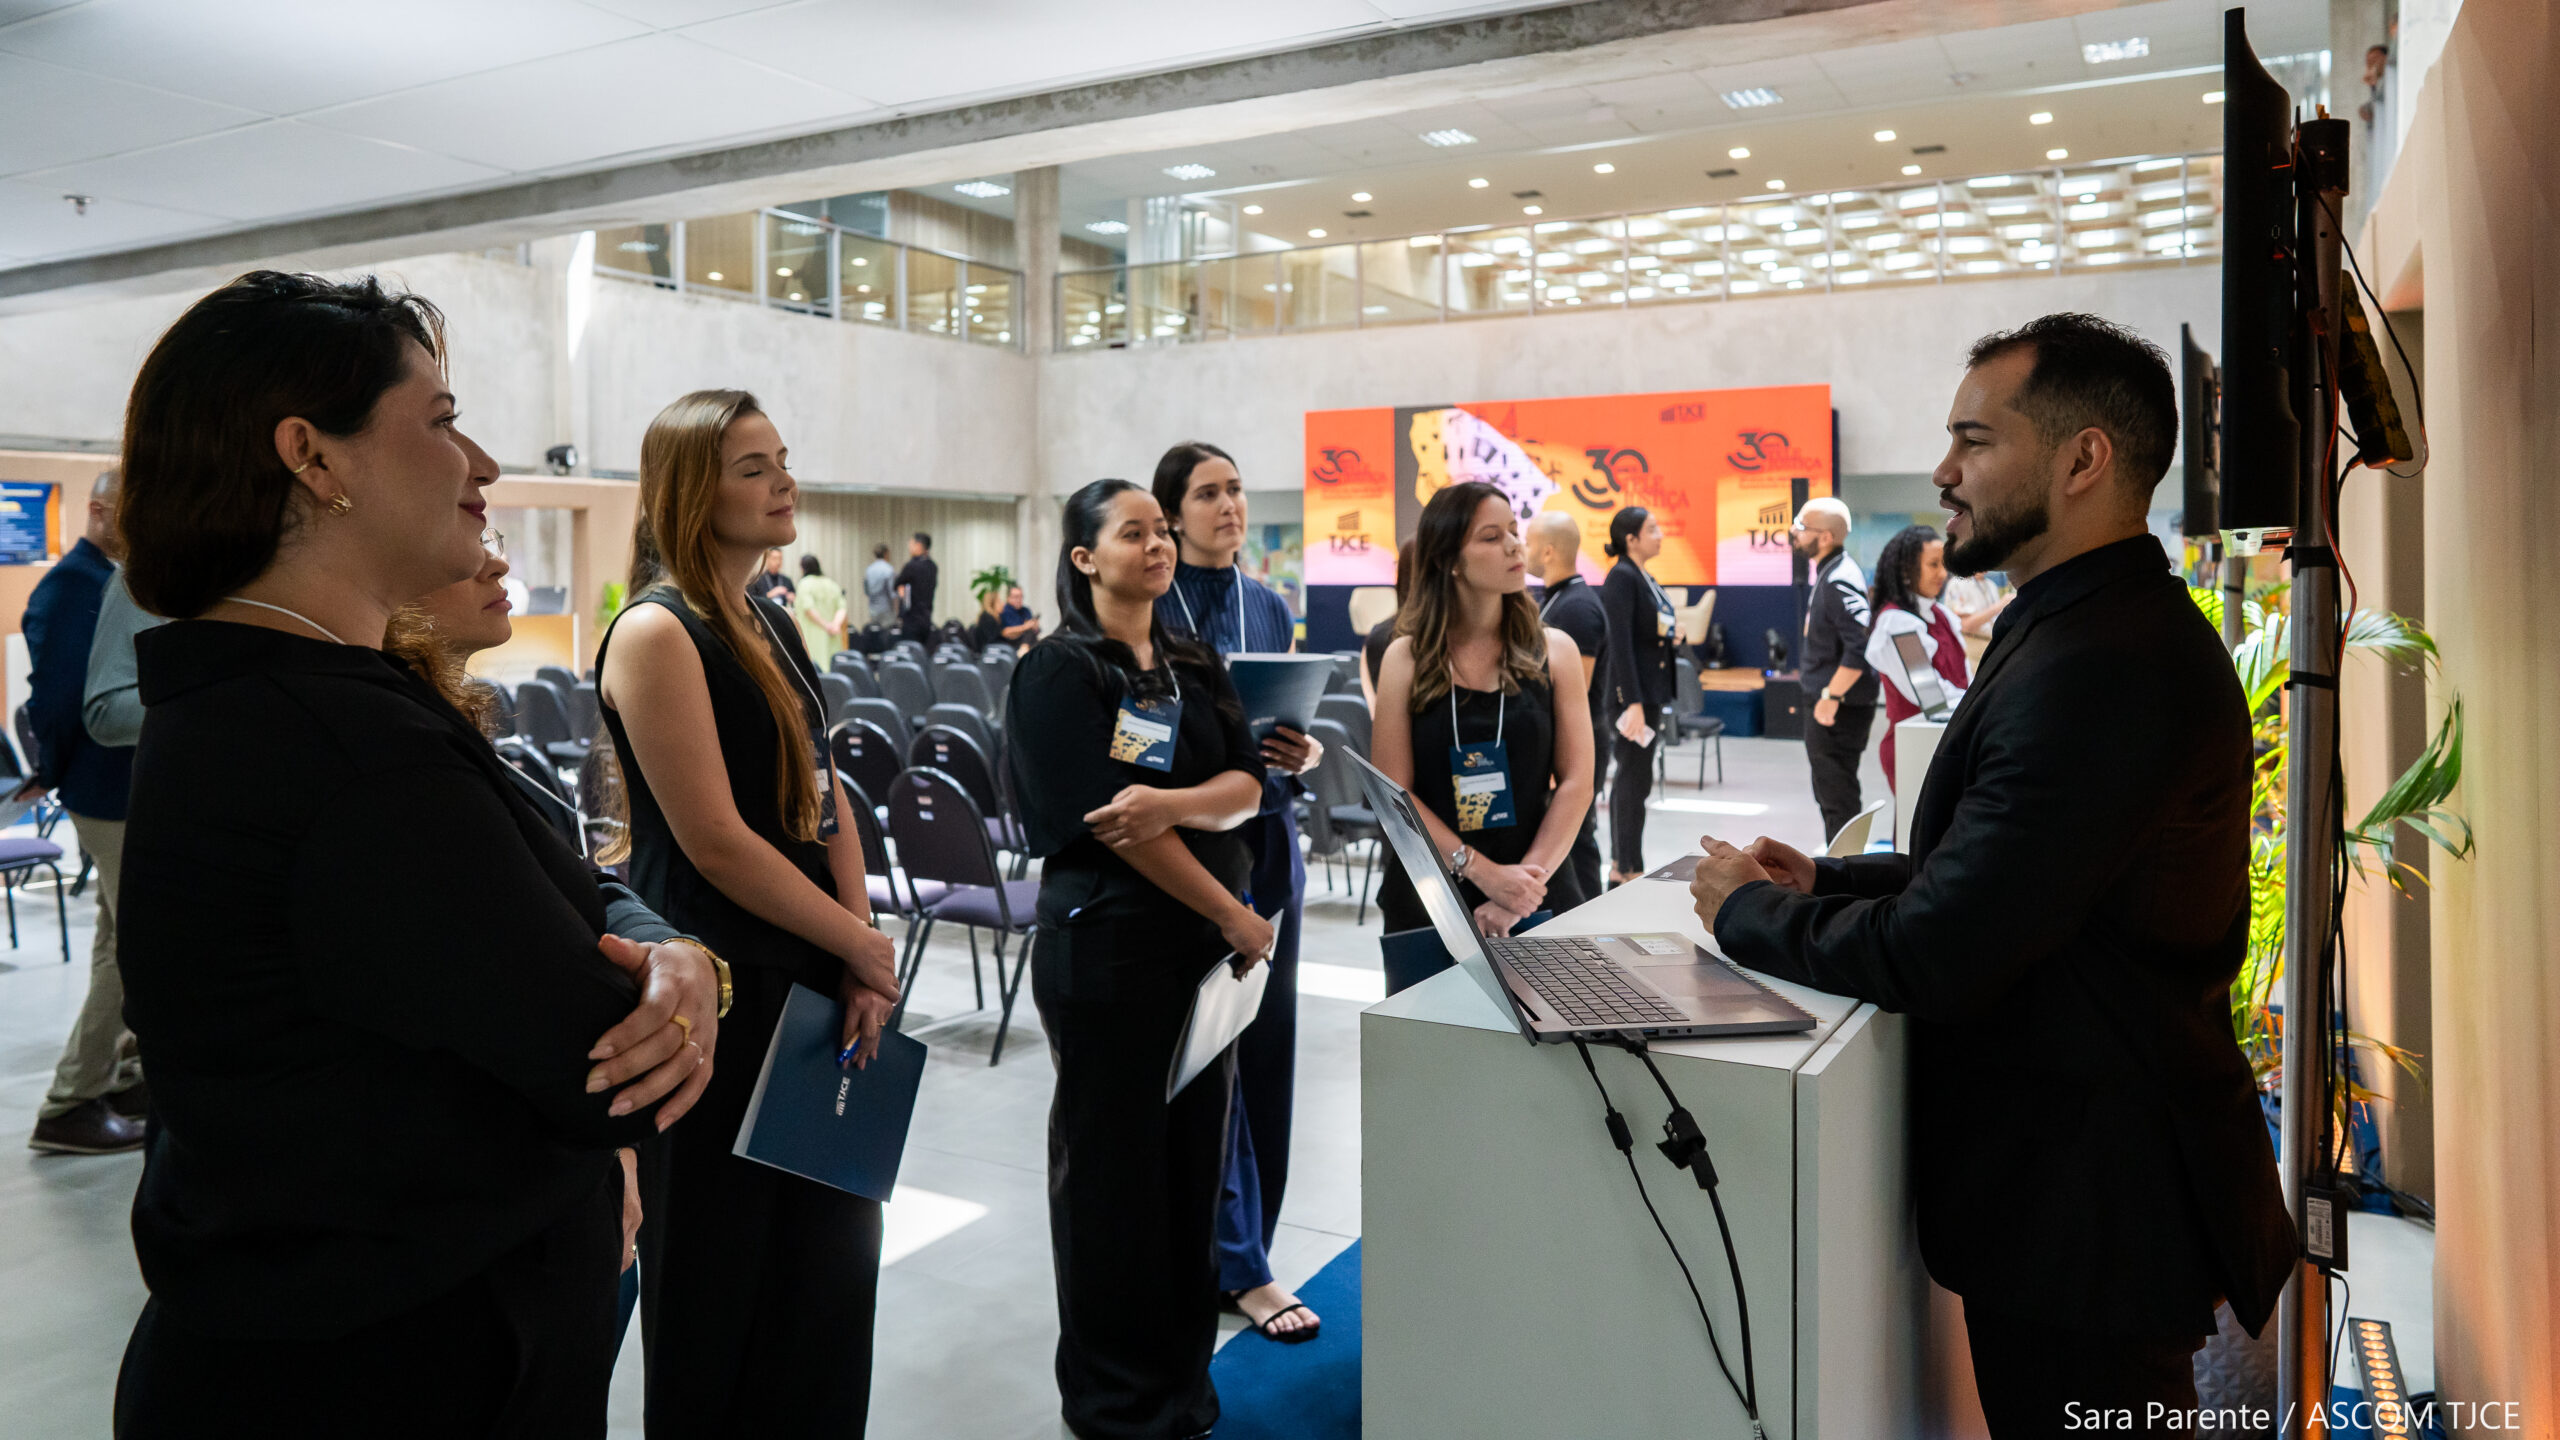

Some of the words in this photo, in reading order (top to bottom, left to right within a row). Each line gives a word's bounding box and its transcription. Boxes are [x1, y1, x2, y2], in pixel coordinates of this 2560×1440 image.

[1572, 449, 1649, 509] 30
[1329, 534, 1370, 551] TJCE
[838, 1076, 851, 1101] TJCE
